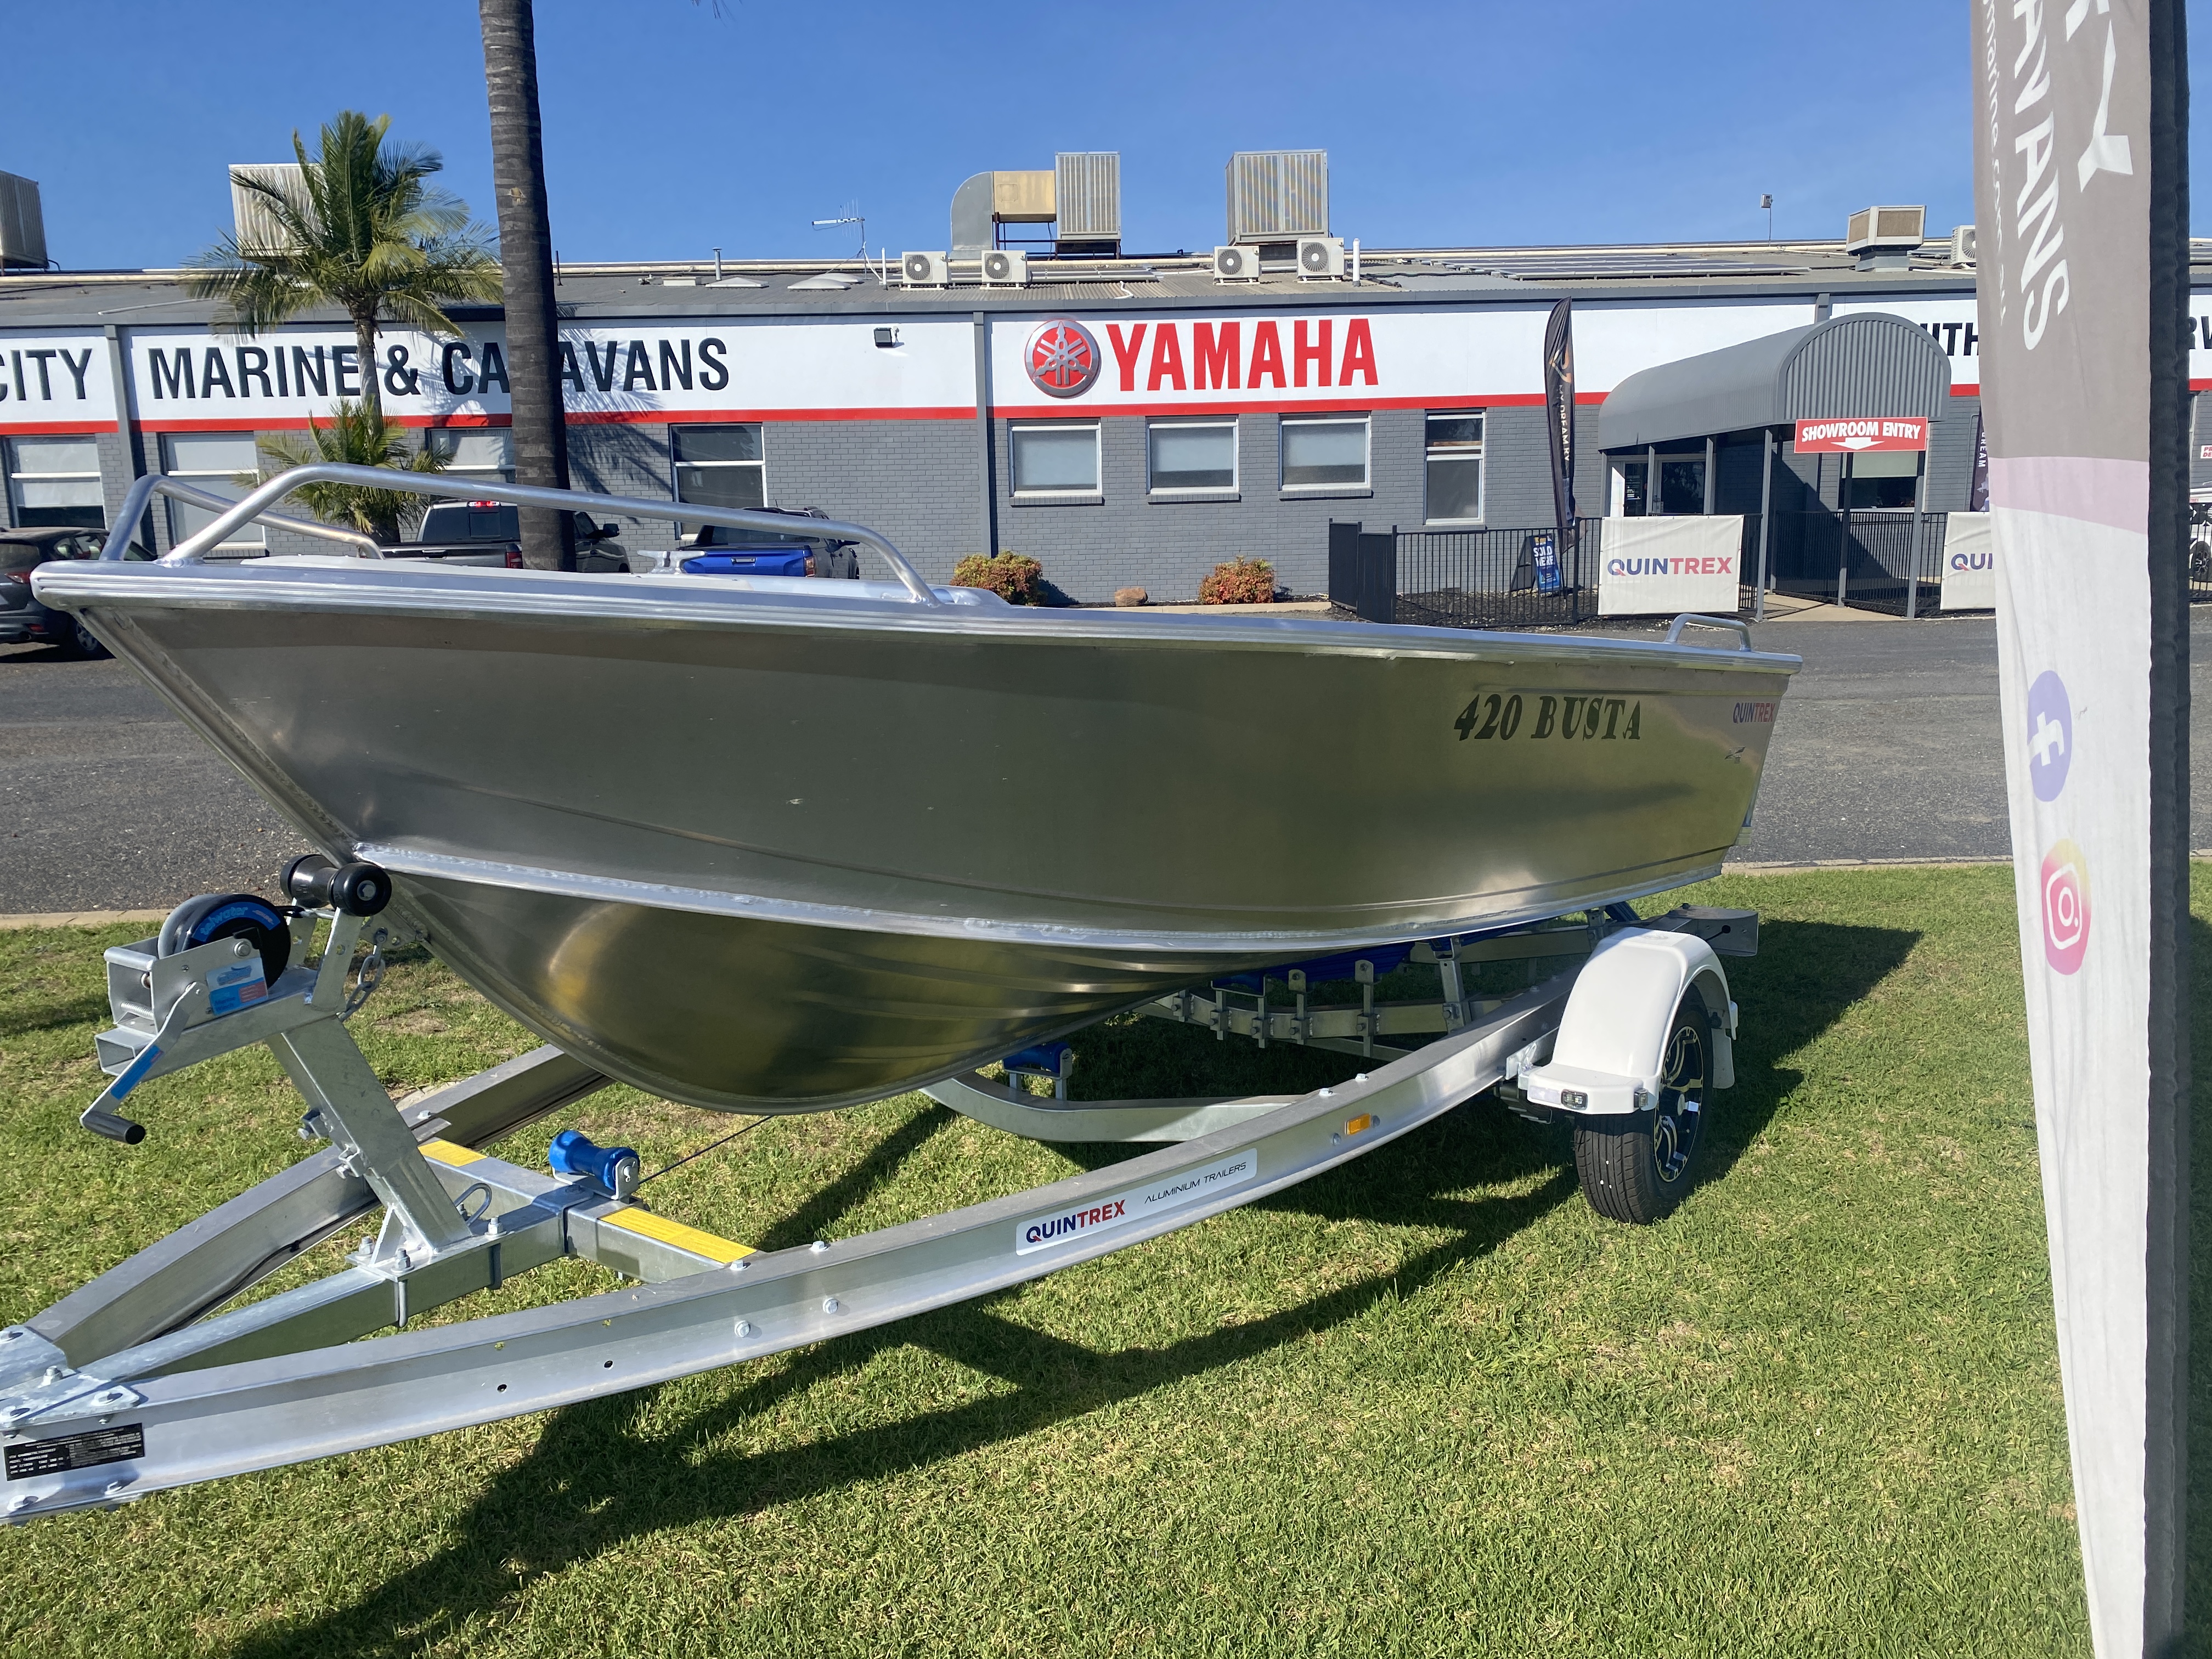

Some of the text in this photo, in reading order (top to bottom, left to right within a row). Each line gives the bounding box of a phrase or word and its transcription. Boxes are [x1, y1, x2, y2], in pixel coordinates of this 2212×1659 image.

[2013, 0, 2070, 350] AVANS
[148, 337, 729, 399] MARINE & CAAVANS
[1106, 319, 1379, 391] YAMAHA
[1560, 404, 1569, 444] DREAM
[1802, 421, 1921, 442] SHOWROOM ENTRY
[1607, 557, 1732, 576] QUINTREX
[1454, 694, 1641, 741] 420 BUSTA
[1733, 702, 1776, 724] QUINTREX
[1026, 1161, 1247, 1243] QUINTREX ALUMINIUM TRAILERS
